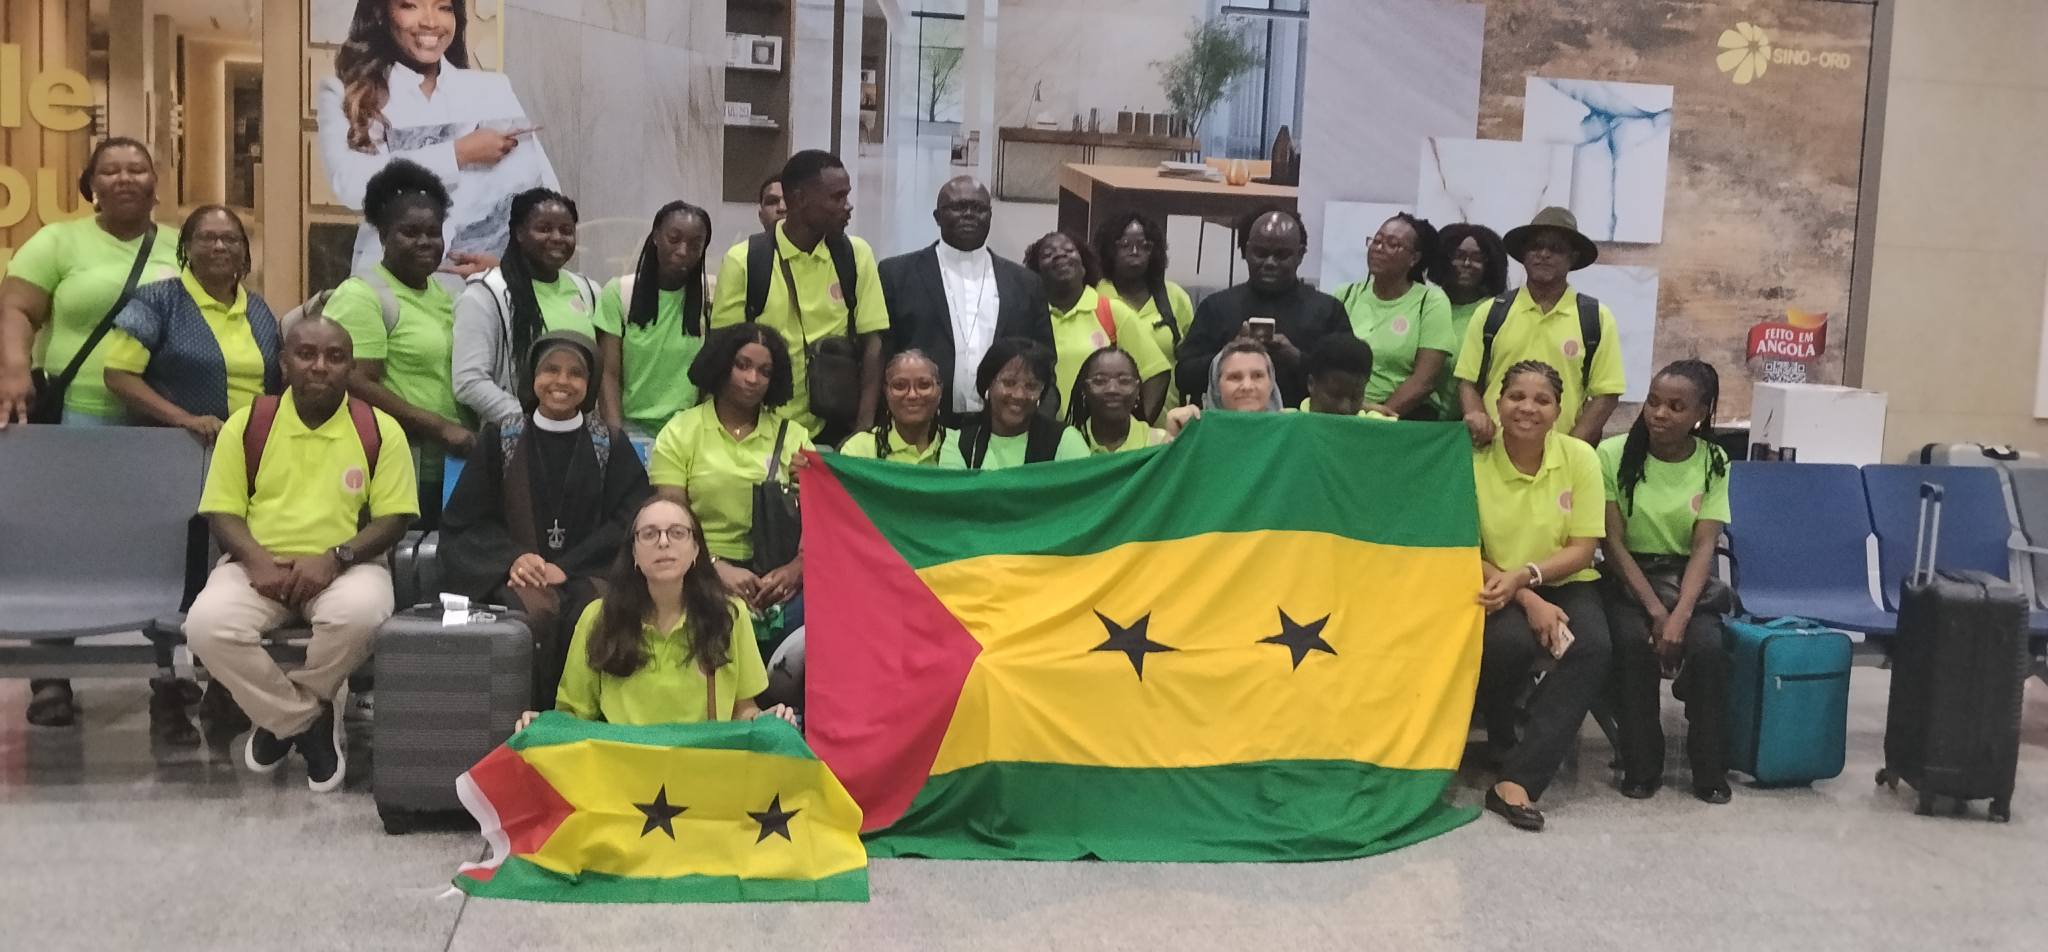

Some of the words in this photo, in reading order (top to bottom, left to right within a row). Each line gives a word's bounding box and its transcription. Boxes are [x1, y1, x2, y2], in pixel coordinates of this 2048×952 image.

[1773, 47, 1850, 70] SINO-ORD
[1765, 328, 1794, 340] FEITO
[1799, 332, 1814, 343] EM
[1756, 340, 1815, 357] ANGOLA
